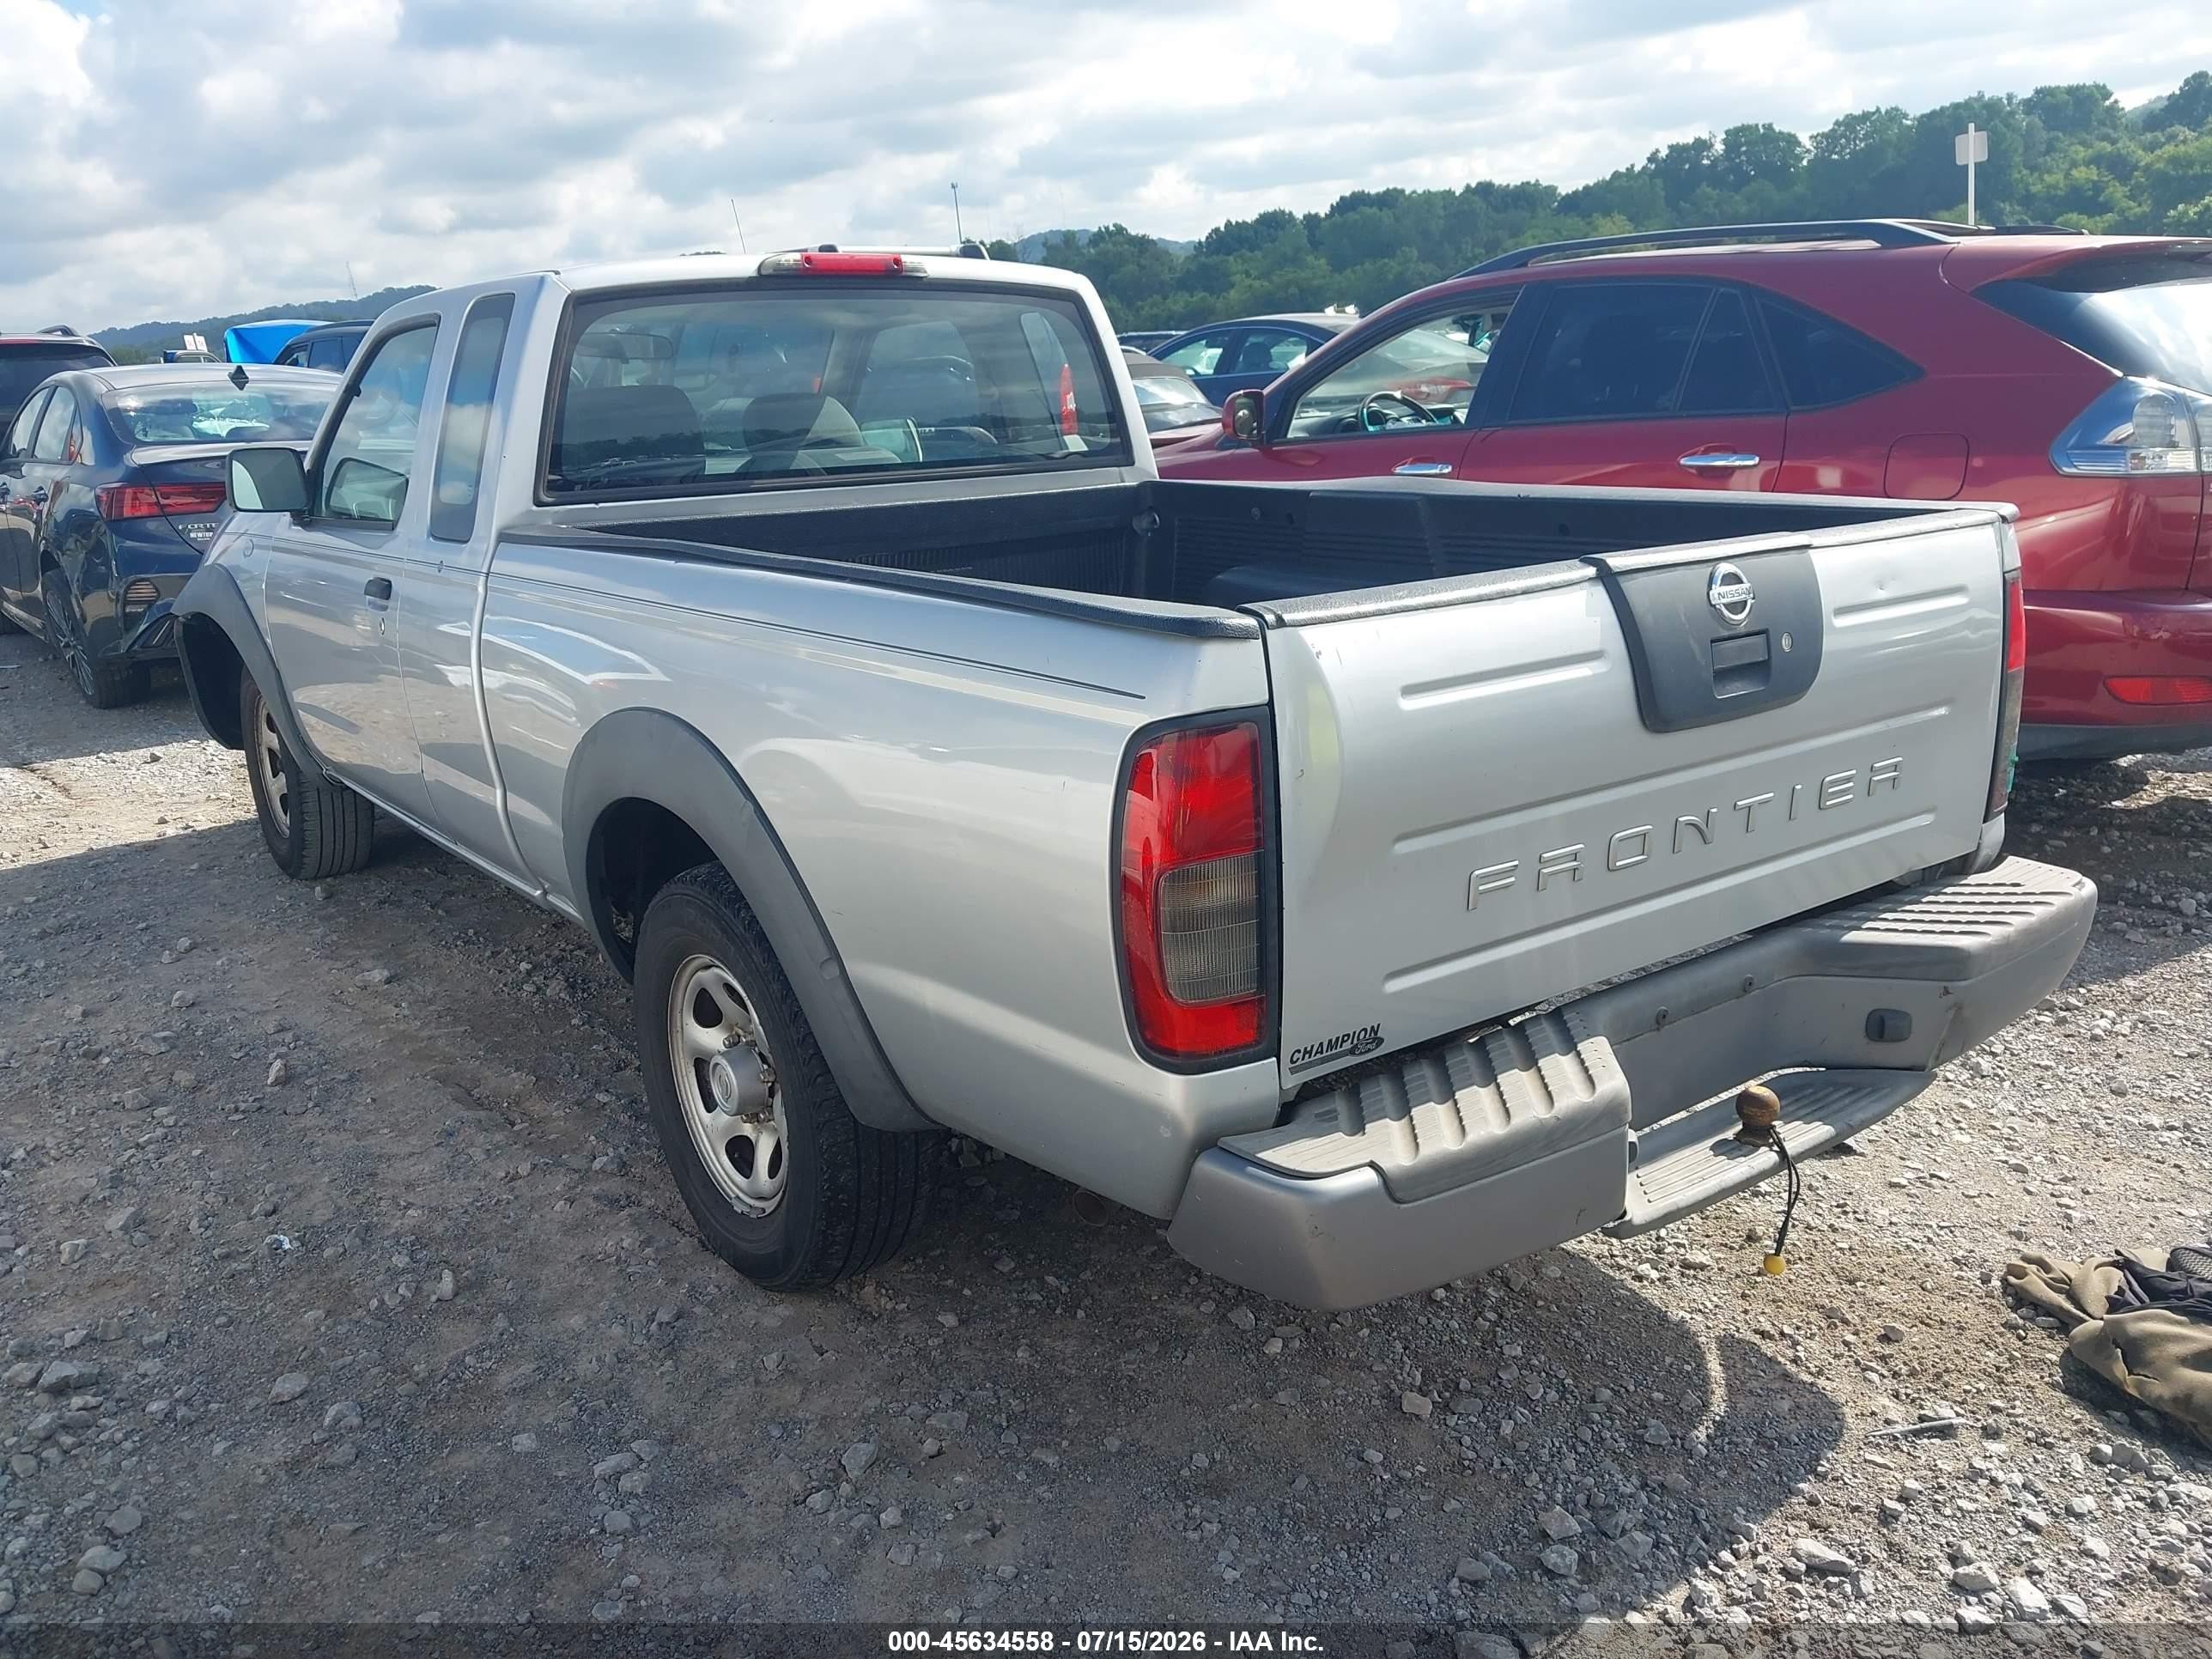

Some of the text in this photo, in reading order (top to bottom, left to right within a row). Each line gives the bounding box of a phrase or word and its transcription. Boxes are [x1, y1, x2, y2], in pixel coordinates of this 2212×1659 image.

[1717, 586, 1752, 601] NISSAN
[1467, 756, 1904, 912] FRONTIER
[1289, 1023, 1381, 1065] CHAMPION
[1354, 1037, 1379, 1054] Ford
